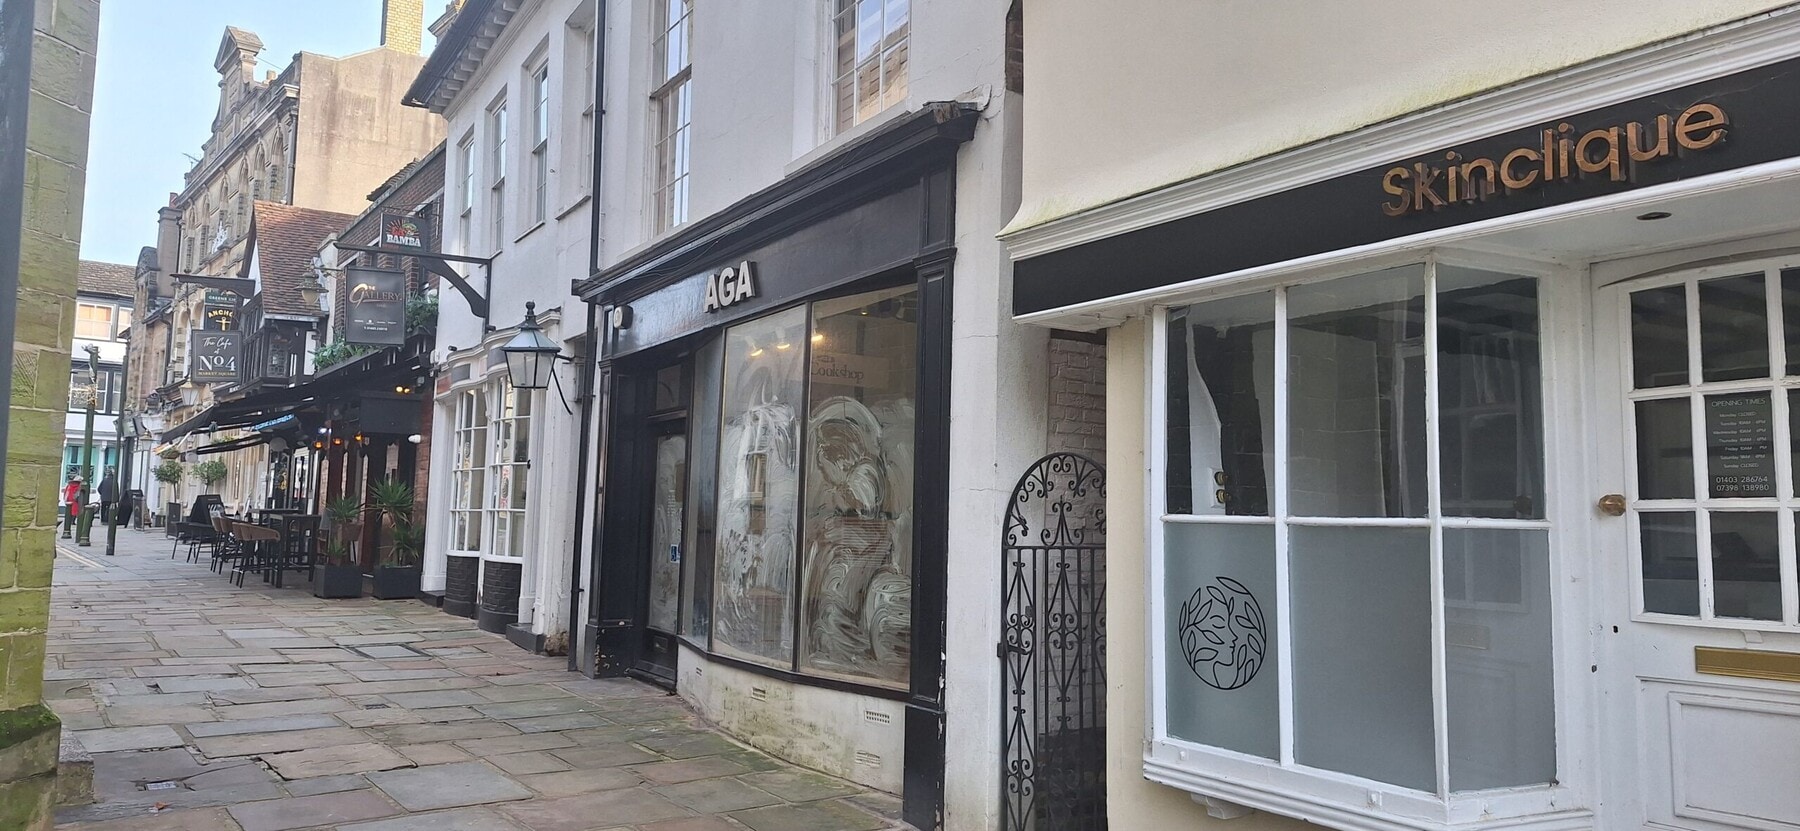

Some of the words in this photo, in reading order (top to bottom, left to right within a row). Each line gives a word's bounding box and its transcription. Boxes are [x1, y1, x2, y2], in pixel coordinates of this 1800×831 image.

[1382, 103, 1730, 216] Skinclique
[386, 233, 421, 247] BAMBA
[703, 260, 756, 314] AGA
[202, 336, 217, 347] The
[811, 361, 864, 384] Cookshop
[1711, 399, 1743, 407] OPENING
[1745, 397, 1766, 405] TIMES
